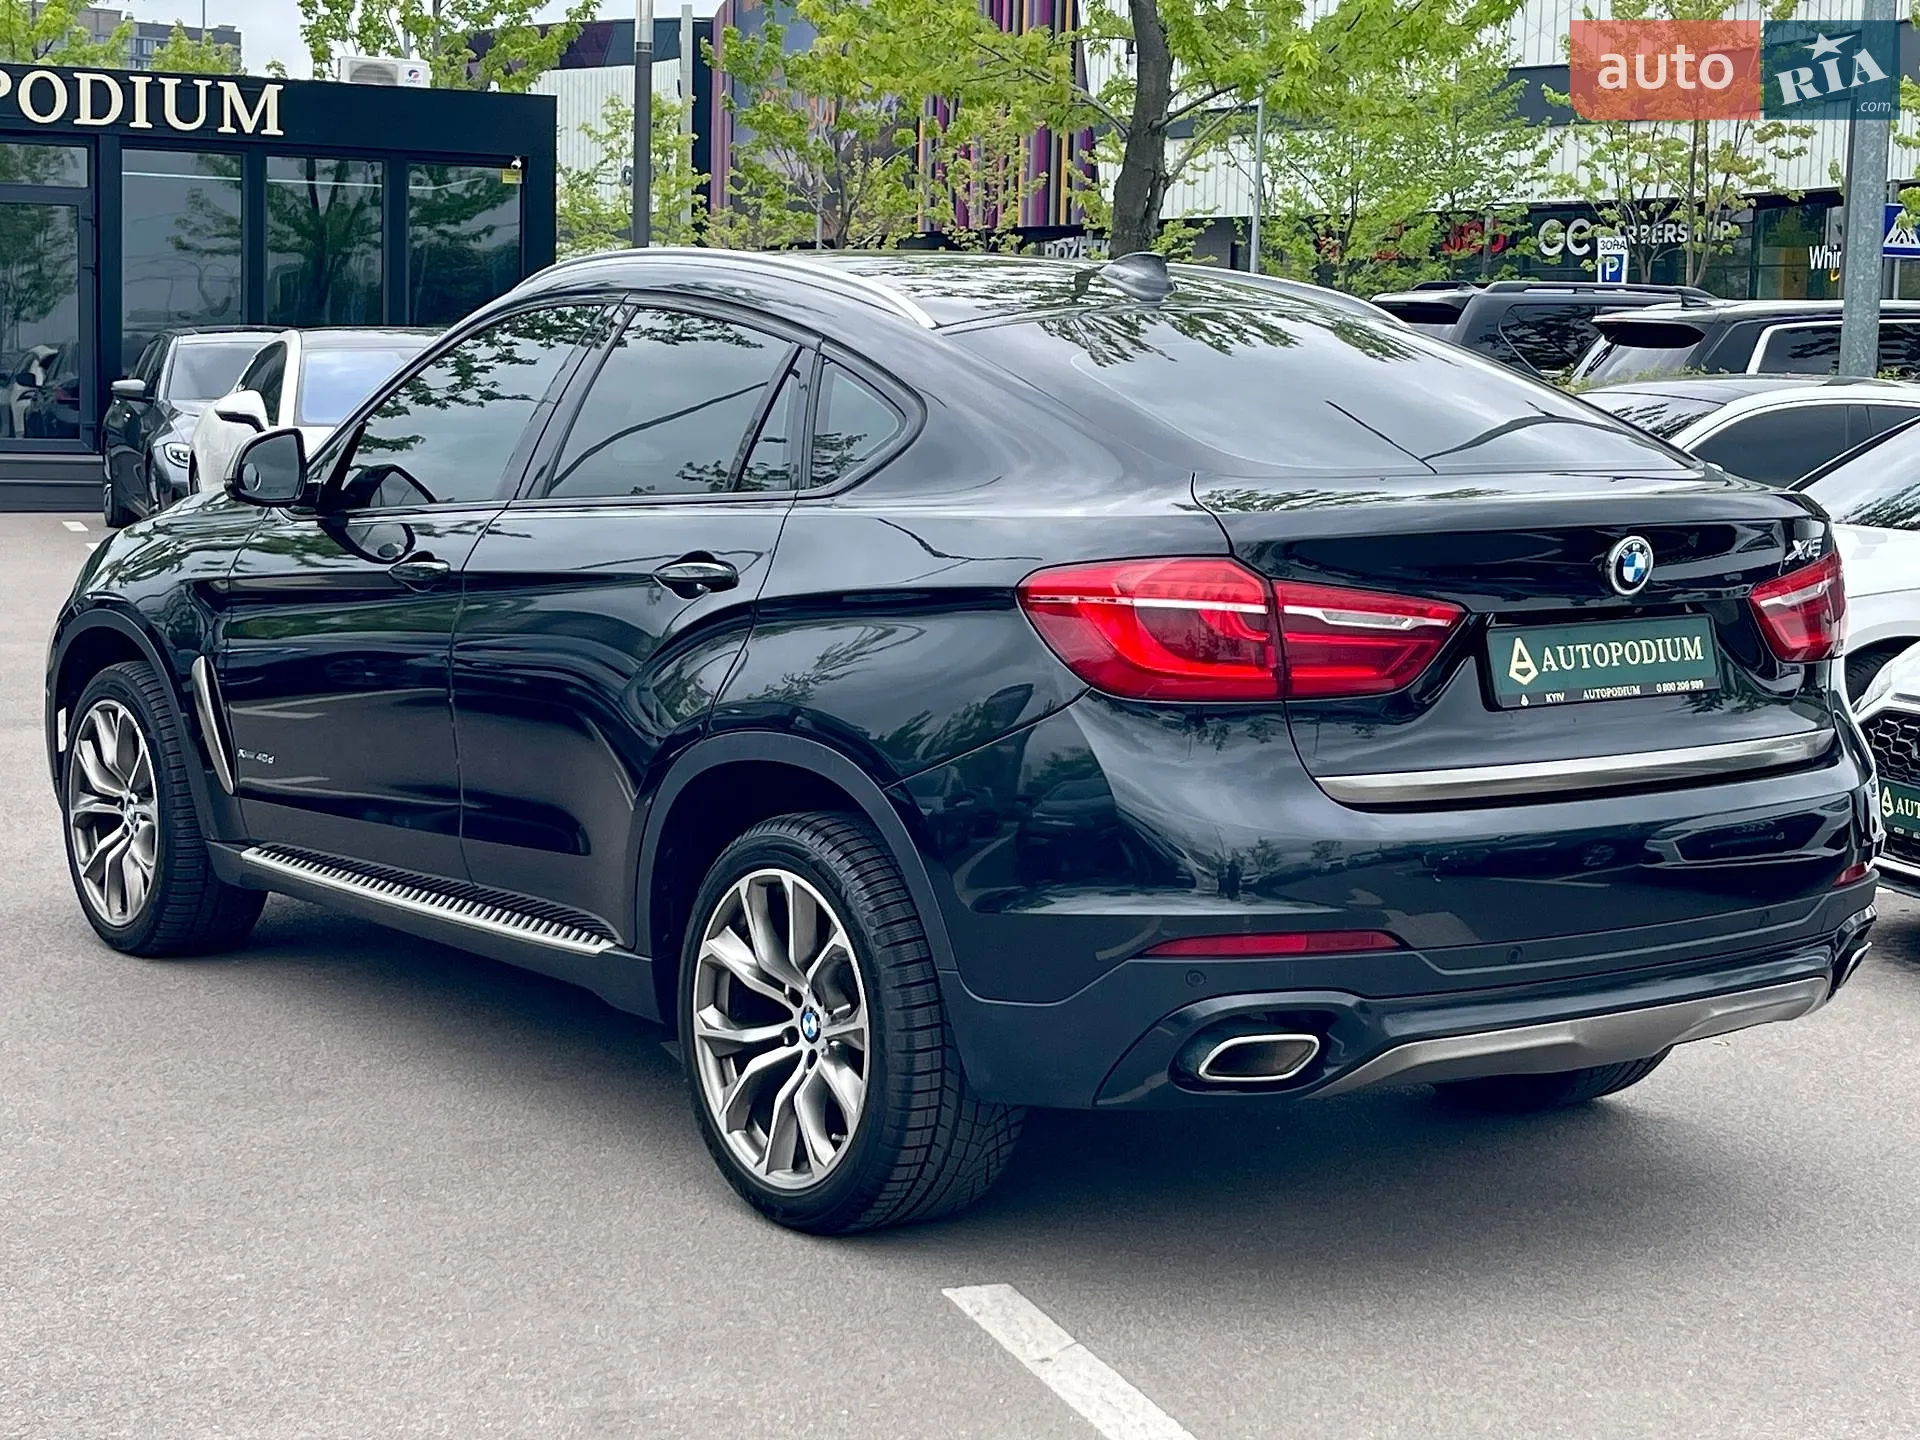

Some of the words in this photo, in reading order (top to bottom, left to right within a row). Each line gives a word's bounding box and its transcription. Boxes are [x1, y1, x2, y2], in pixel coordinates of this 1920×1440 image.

[0, 70, 284, 136] ODIUM
[1541, 636, 1704, 673] AUTOPODIUM
[1583, 685, 1641, 700] AUTOPODIUM
